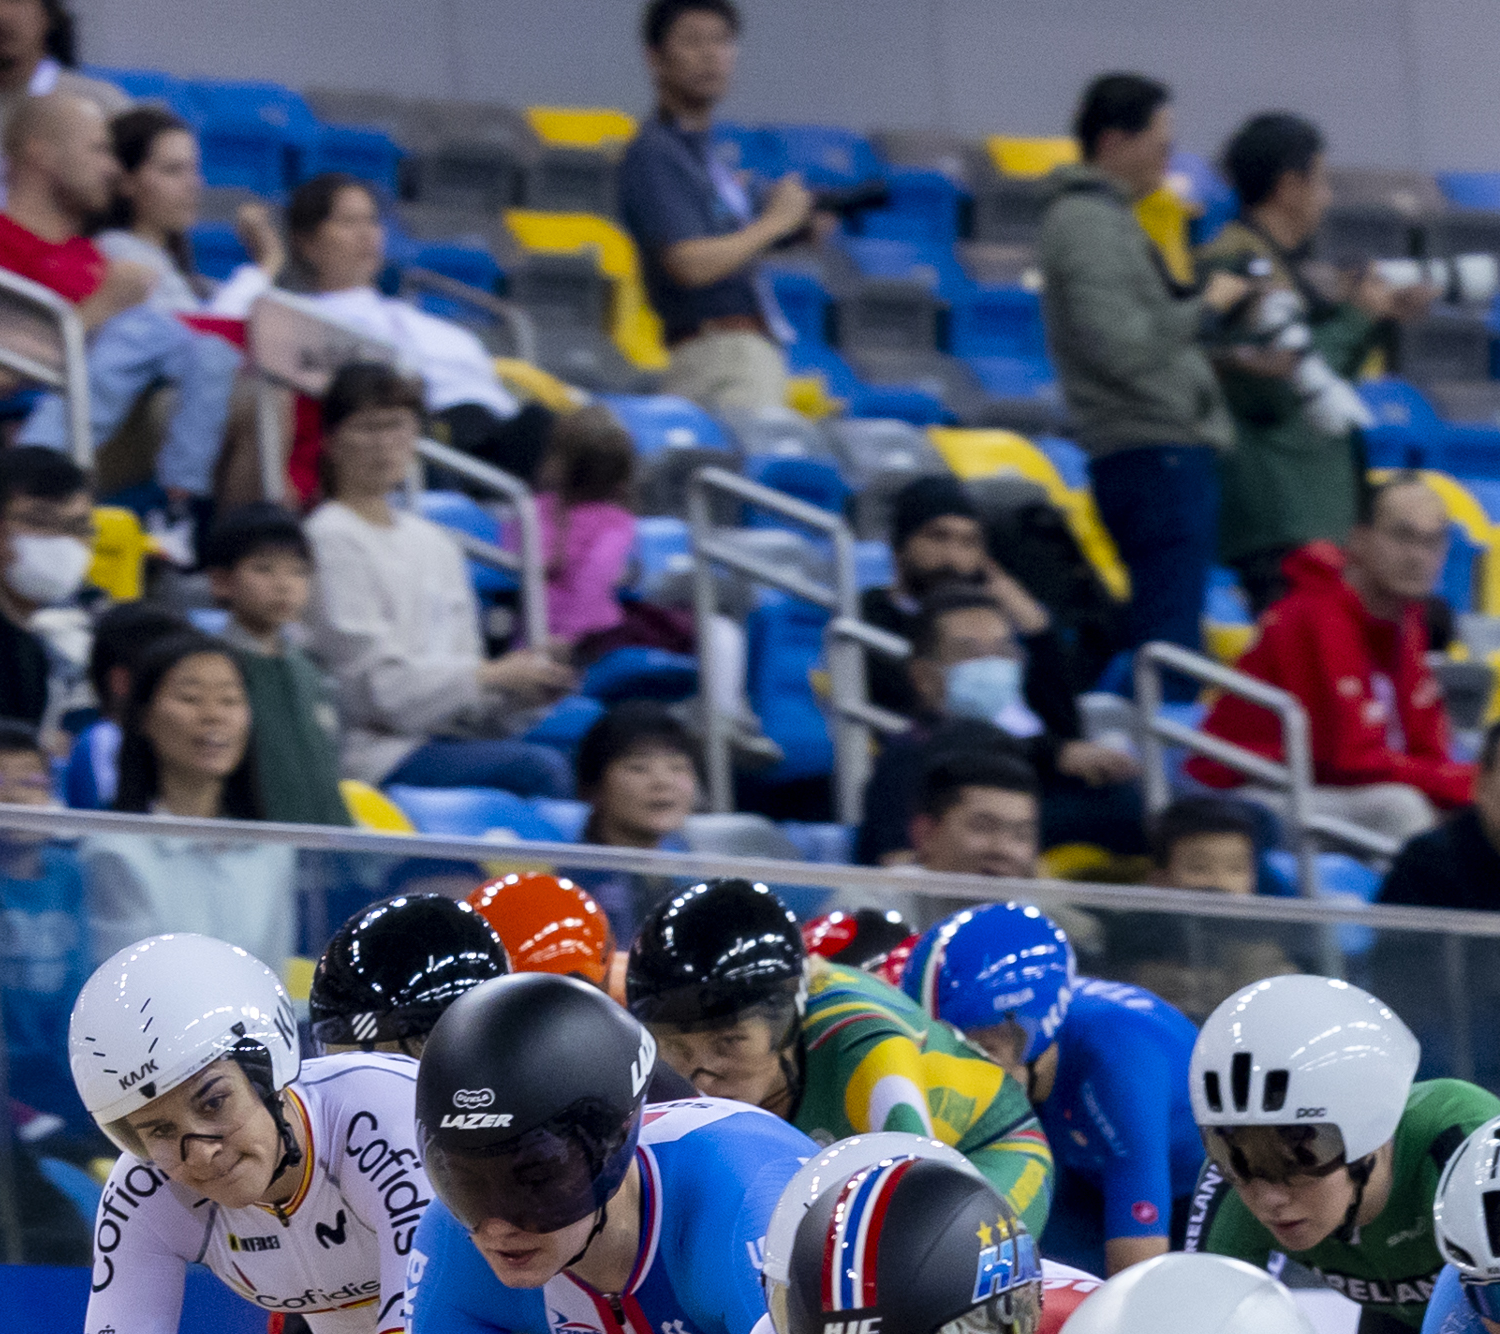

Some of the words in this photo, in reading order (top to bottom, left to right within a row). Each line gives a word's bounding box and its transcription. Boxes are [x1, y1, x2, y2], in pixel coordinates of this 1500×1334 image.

[439, 1113, 514, 1130] LAZER
[346, 1110, 431, 1256] Cofidis
[255, 1279, 381, 1309] Cofidis
